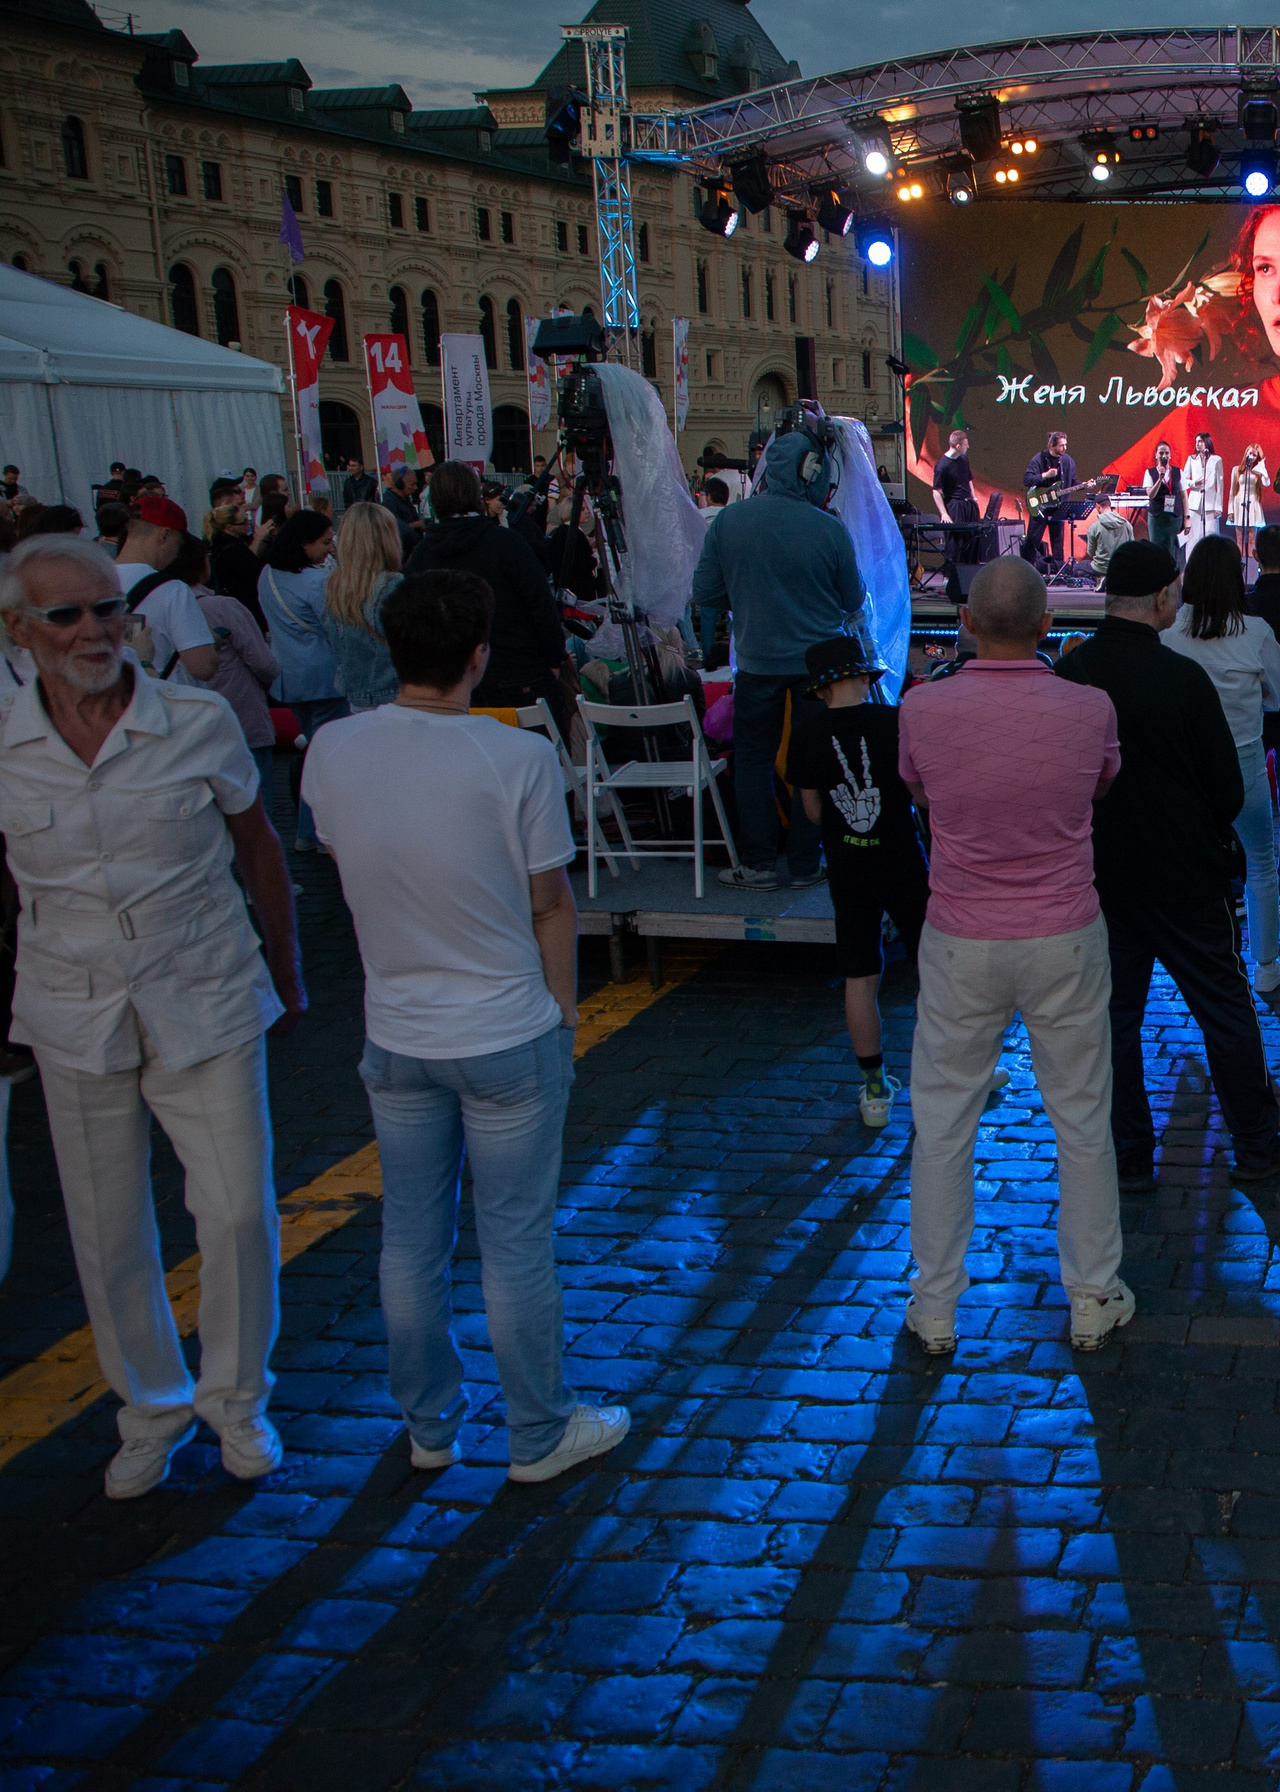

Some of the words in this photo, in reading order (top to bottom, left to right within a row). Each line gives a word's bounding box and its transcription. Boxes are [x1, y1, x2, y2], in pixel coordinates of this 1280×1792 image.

[580, 28, 612, 36] PROLYTE
[370, 341, 402, 373] 14
[472, 354, 483, 402] Москвы
[995, 374, 1086, 405] Женя
[1098, 376, 1259, 410] Львовская
[451, 365, 464, 447] Департамент
[466, 391, 475, 446] культуры
[475, 405, 487, 446] города
